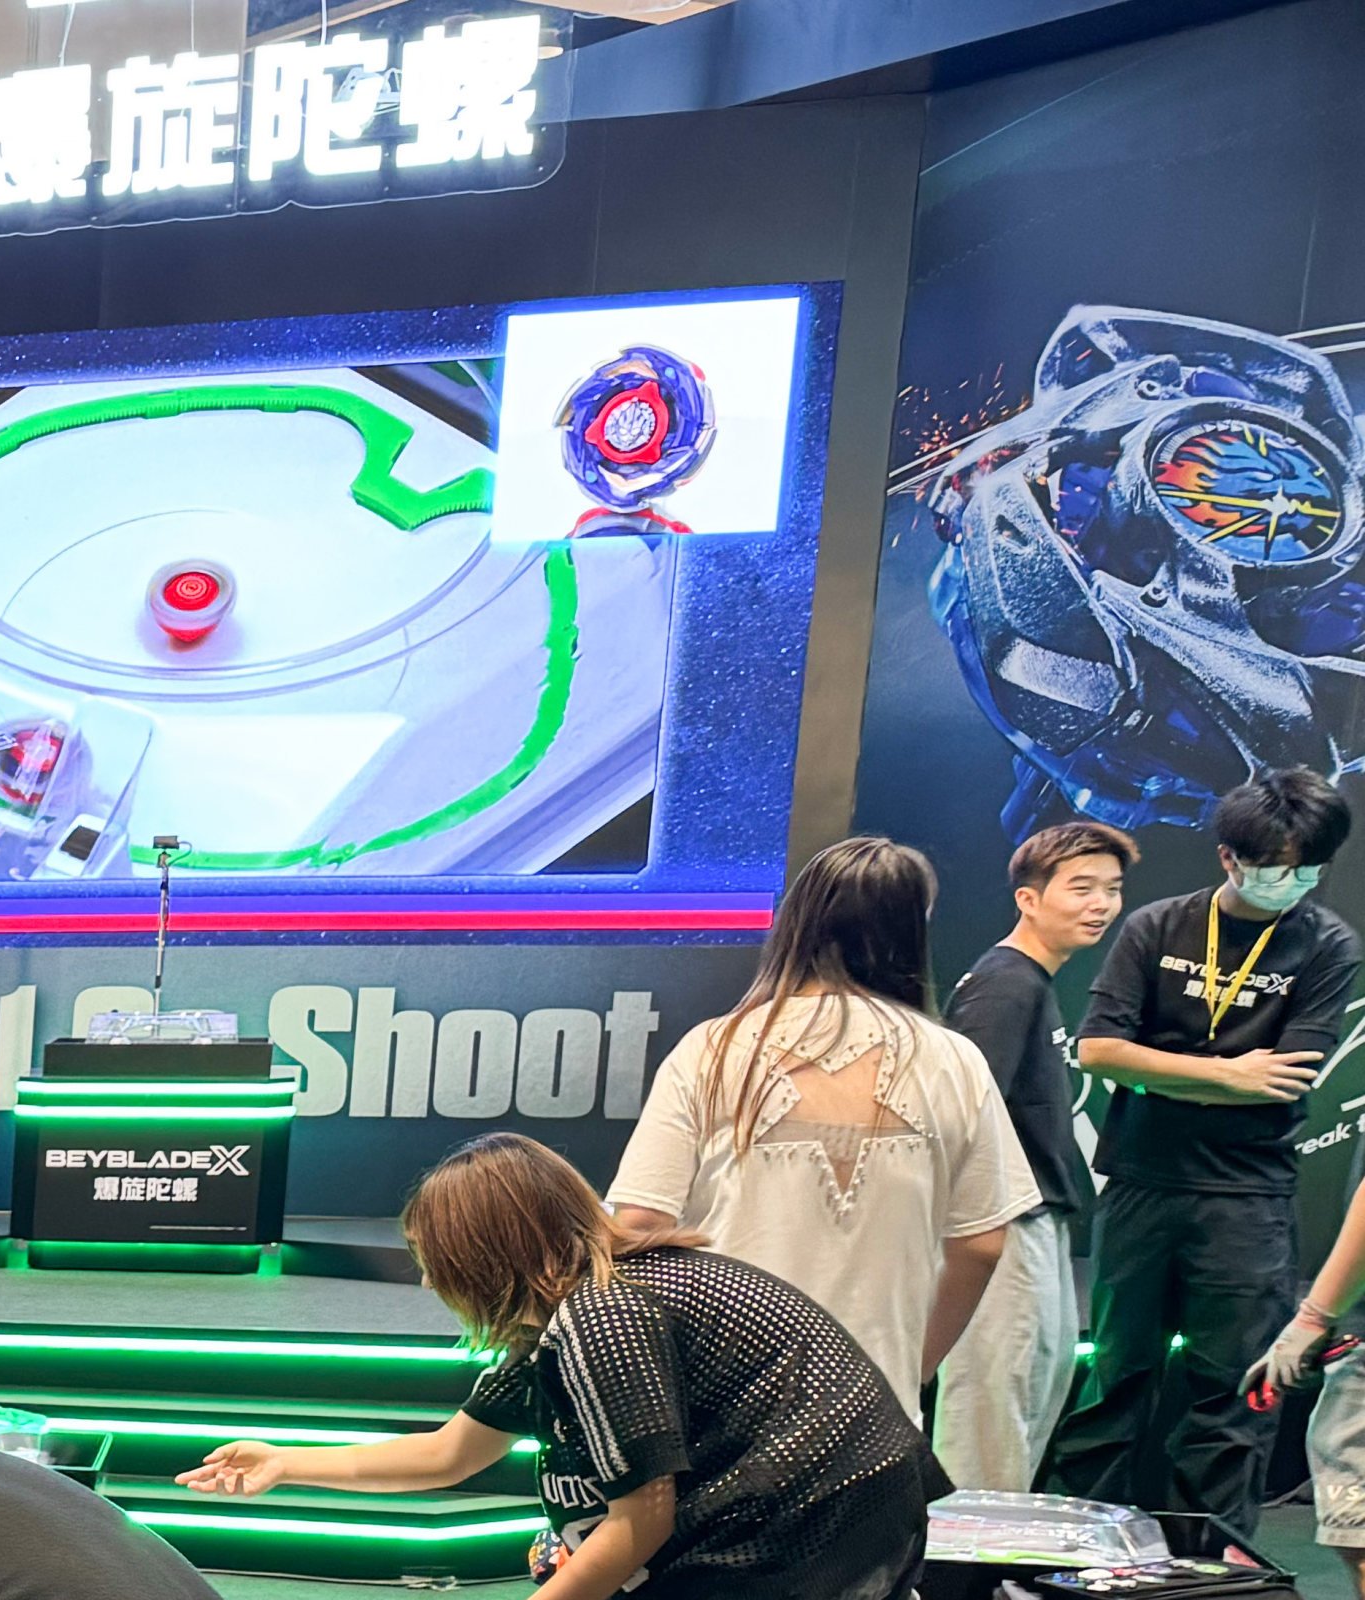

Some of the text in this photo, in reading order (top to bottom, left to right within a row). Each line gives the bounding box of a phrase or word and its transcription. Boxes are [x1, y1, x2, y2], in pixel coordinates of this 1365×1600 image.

[268, 985, 660, 1119] Shoot
[93, 1176, 199, 1202] 爆旋陀螺
